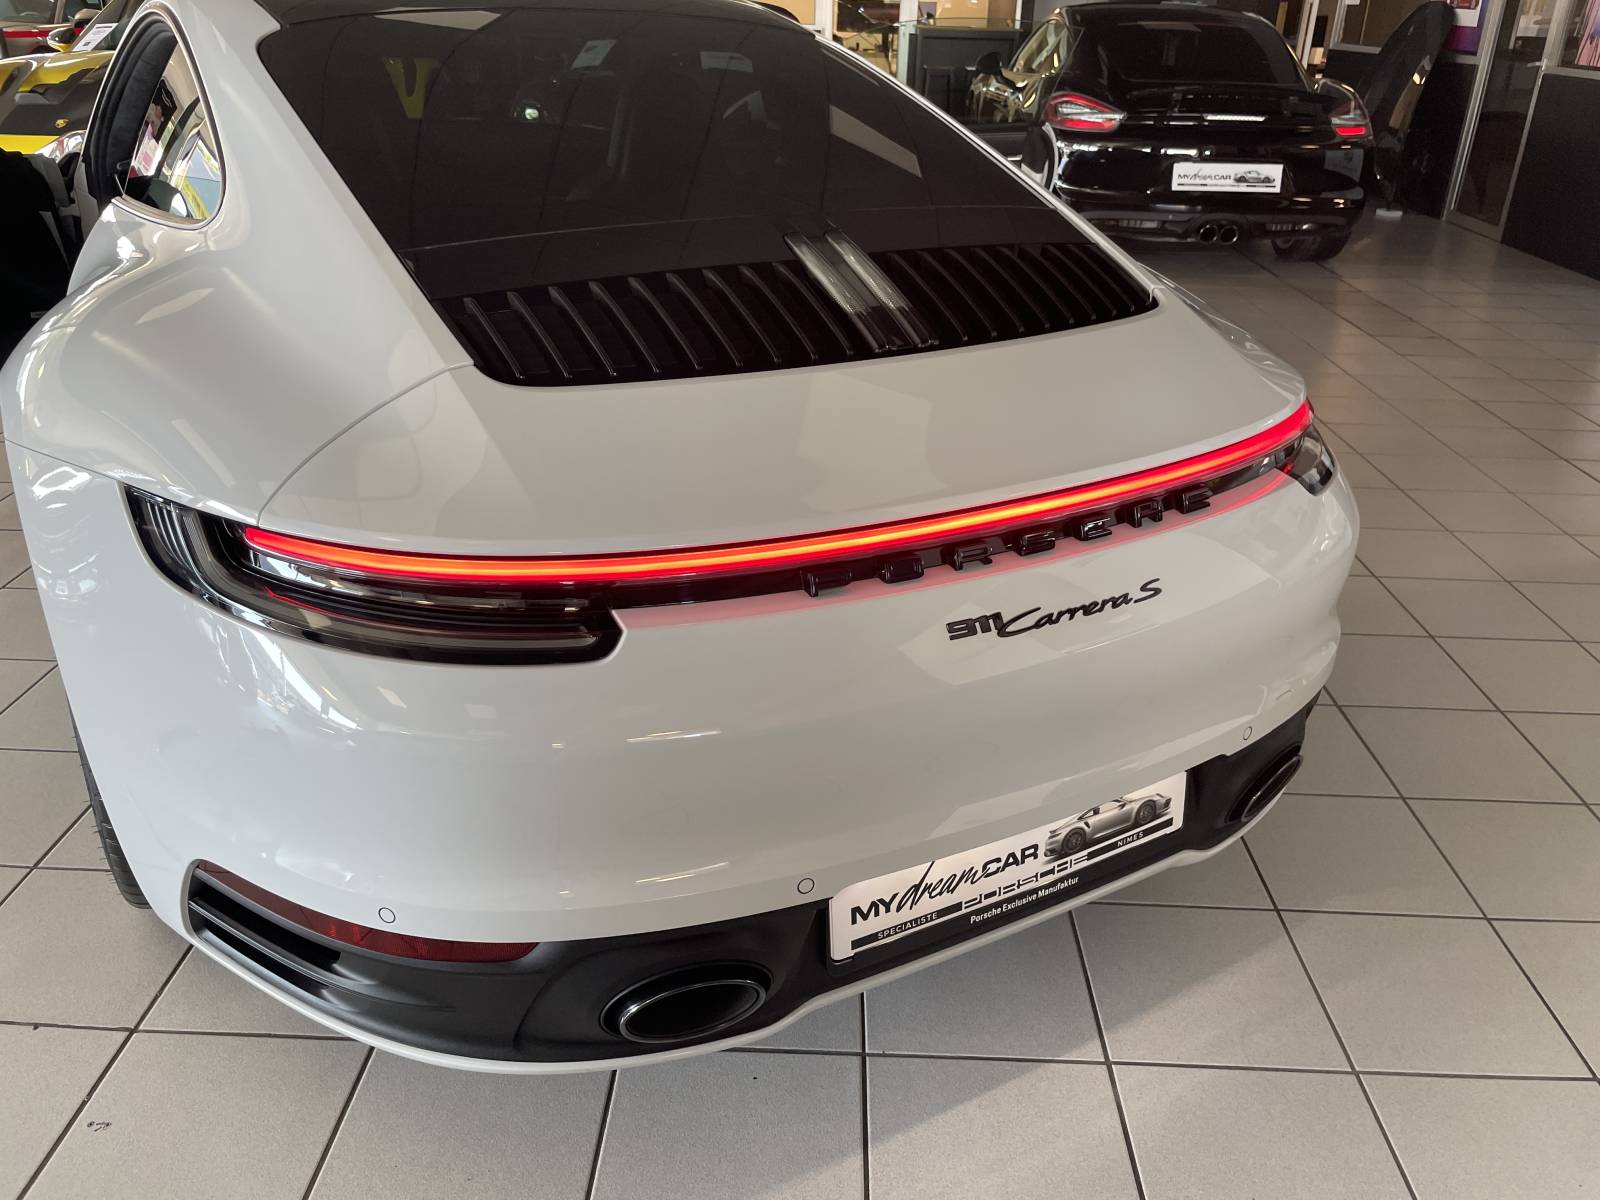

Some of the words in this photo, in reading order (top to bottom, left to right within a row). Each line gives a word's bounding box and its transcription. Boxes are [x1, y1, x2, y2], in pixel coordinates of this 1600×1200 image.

[802, 489, 1211, 597] PORSCHE
[946, 611, 1003, 640] 911
[997, 593, 1132, 639] Carrera
[1134, 578, 1162, 604] S
[877, 912, 939, 939] SPECIALISTE
[1117, 831, 1145, 847] NIMES
[981, 843, 1039, 878] CAR
[970, 906, 1001, 924] Porsche
[1002, 894, 1037, 915] Exclusive
[1037, 876, 1080, 899] Manufaktur
